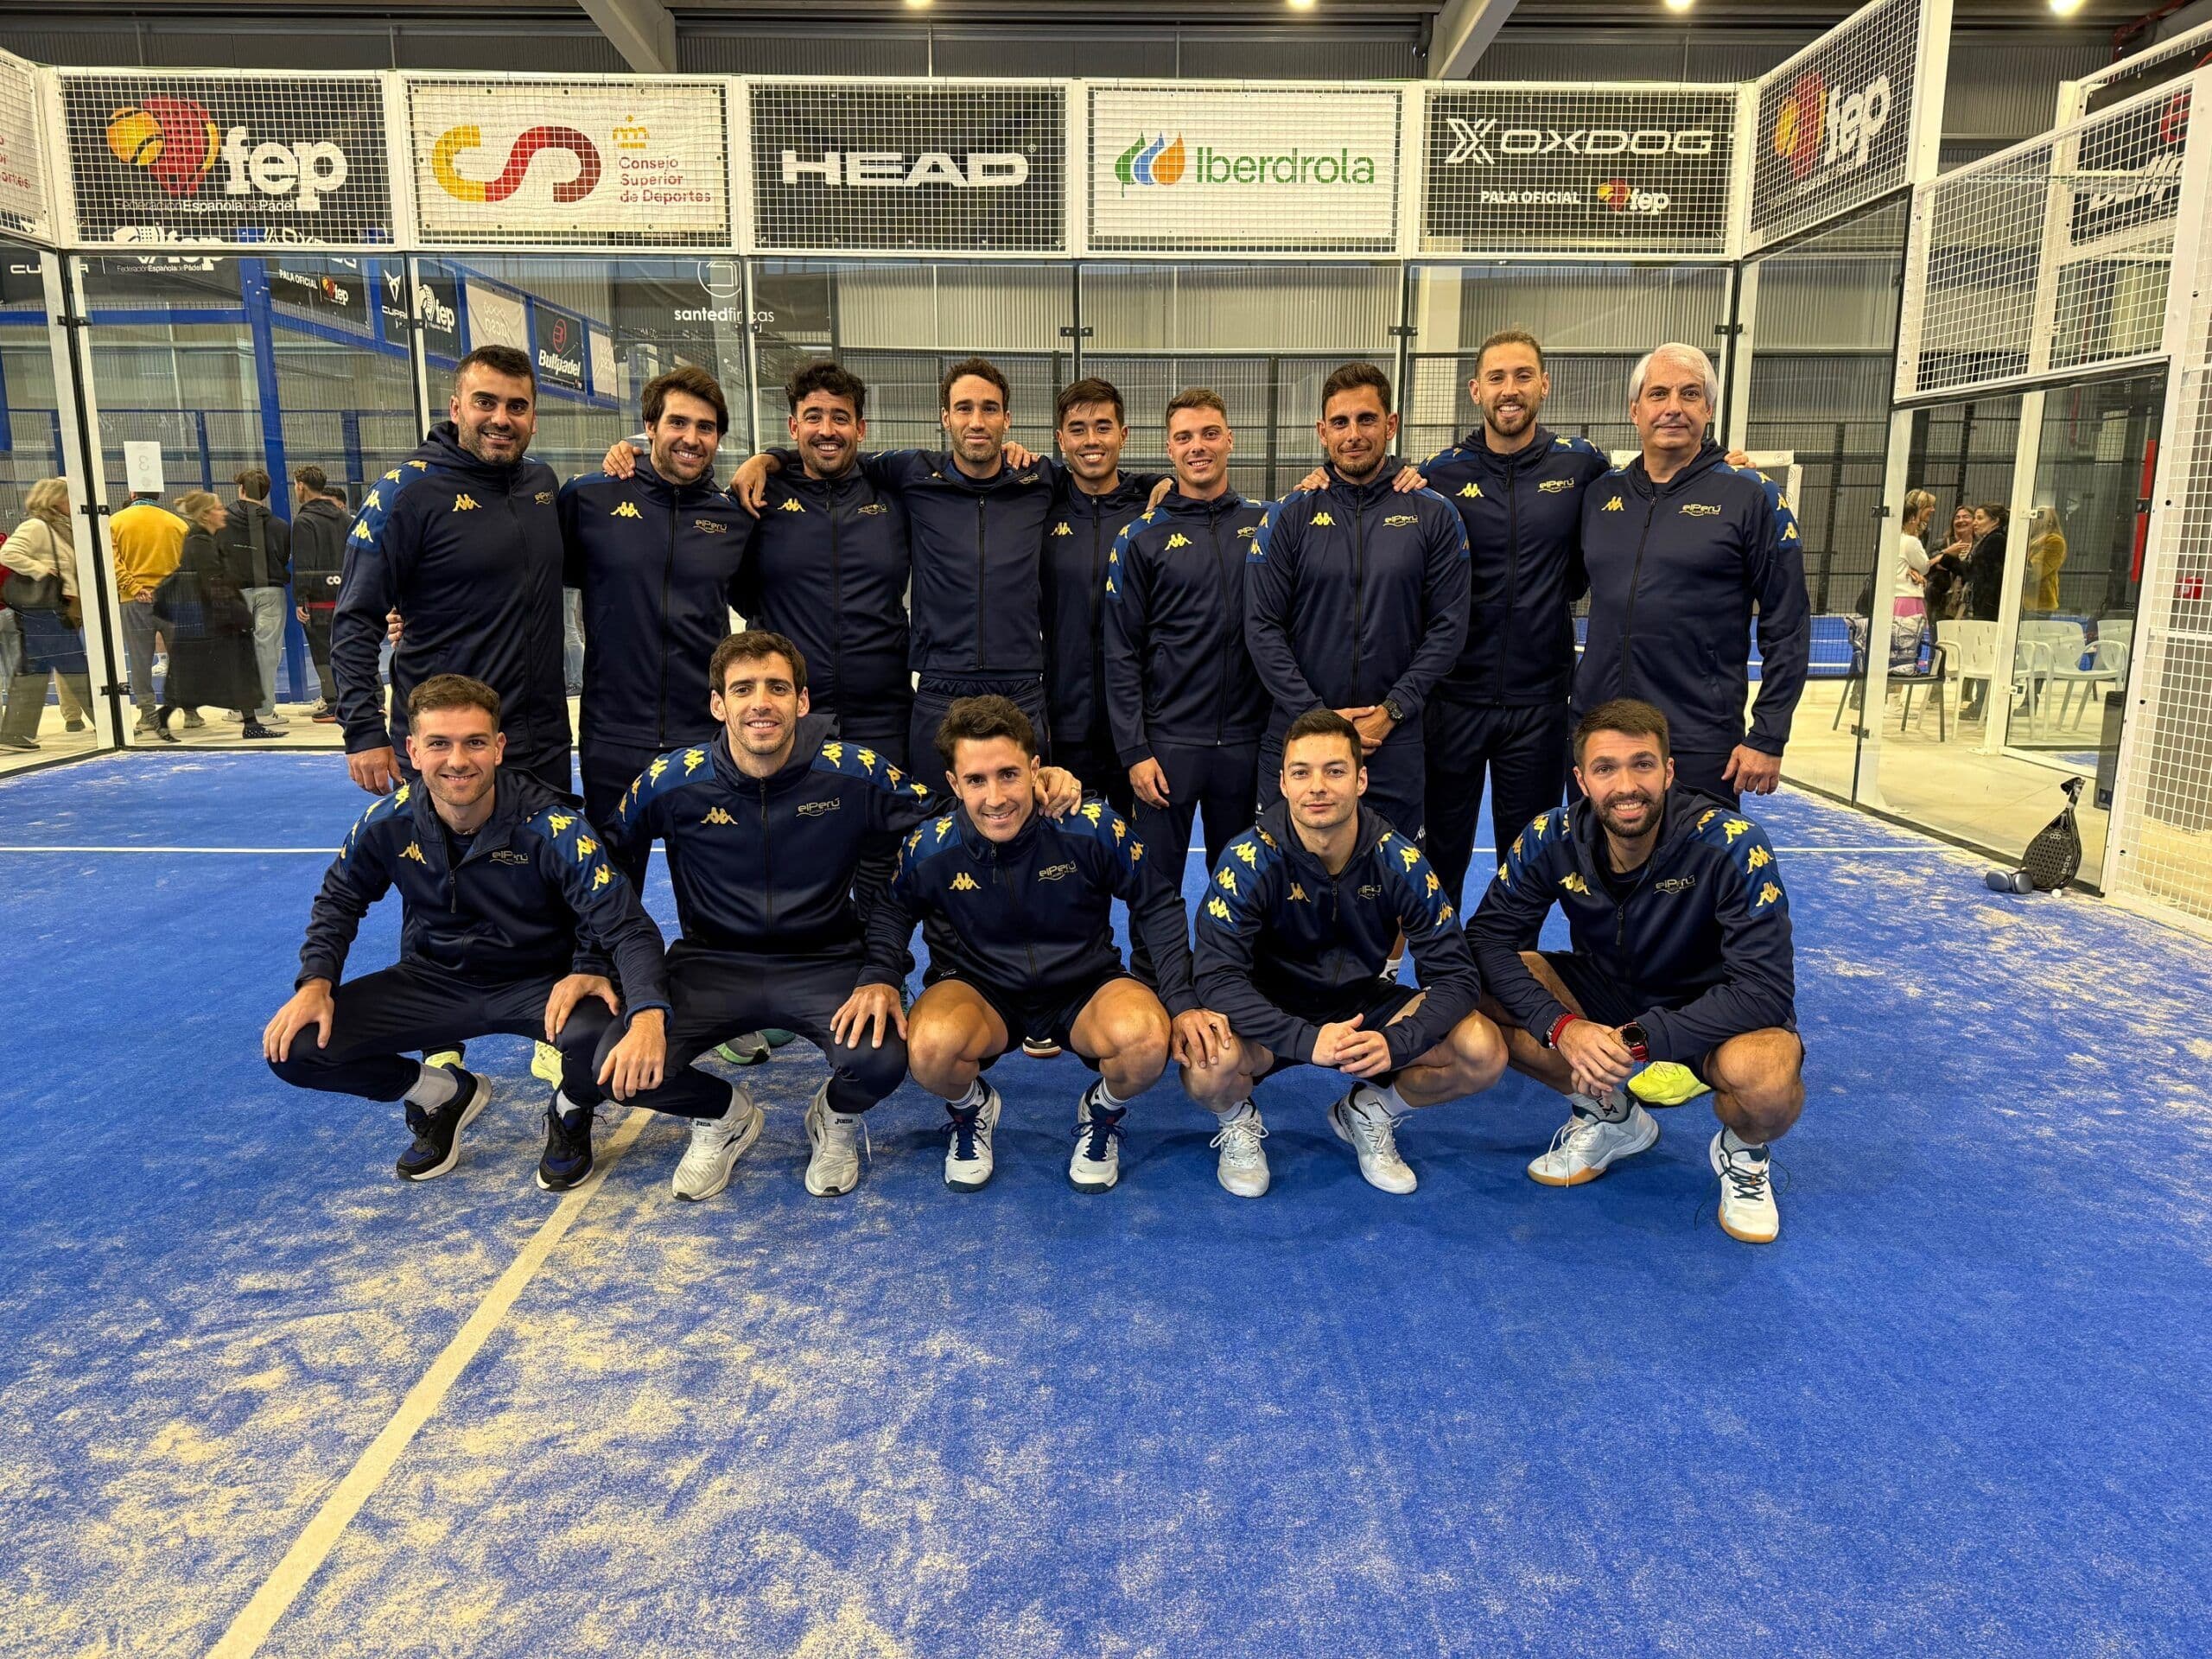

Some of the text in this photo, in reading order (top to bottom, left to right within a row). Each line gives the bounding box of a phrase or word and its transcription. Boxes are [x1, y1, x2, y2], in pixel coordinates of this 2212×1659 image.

[1823, 74, 1891, 168] fep
[1500, 129, 1714, 156] OXDOG
[221, 125, 348, 212] fep
[619, 155, 679, 171] Consejo
[781, 149, 1029, 188] HEAD
[1196, 147, 1375, 184] Iberdrola
[620, 171, 684, 187] Superior
[620, 189, 712, 206] de Deportes
[1480, 188, 1670, 216] PALA OFICIAL fep
[279, 269, 296, 283] PALA
[296, 275, 318, 289] OFICIAL
[435, 298, 455, 334] fep
[538, 349, 581, 378] Bullpadel
[1539, 477, 1575, 490] elPerú
[1682, 504, 1722, 513] elPerú
[798, 797, 841, 813] elPerú
[1039, 860, 1077, 878] elPerú
